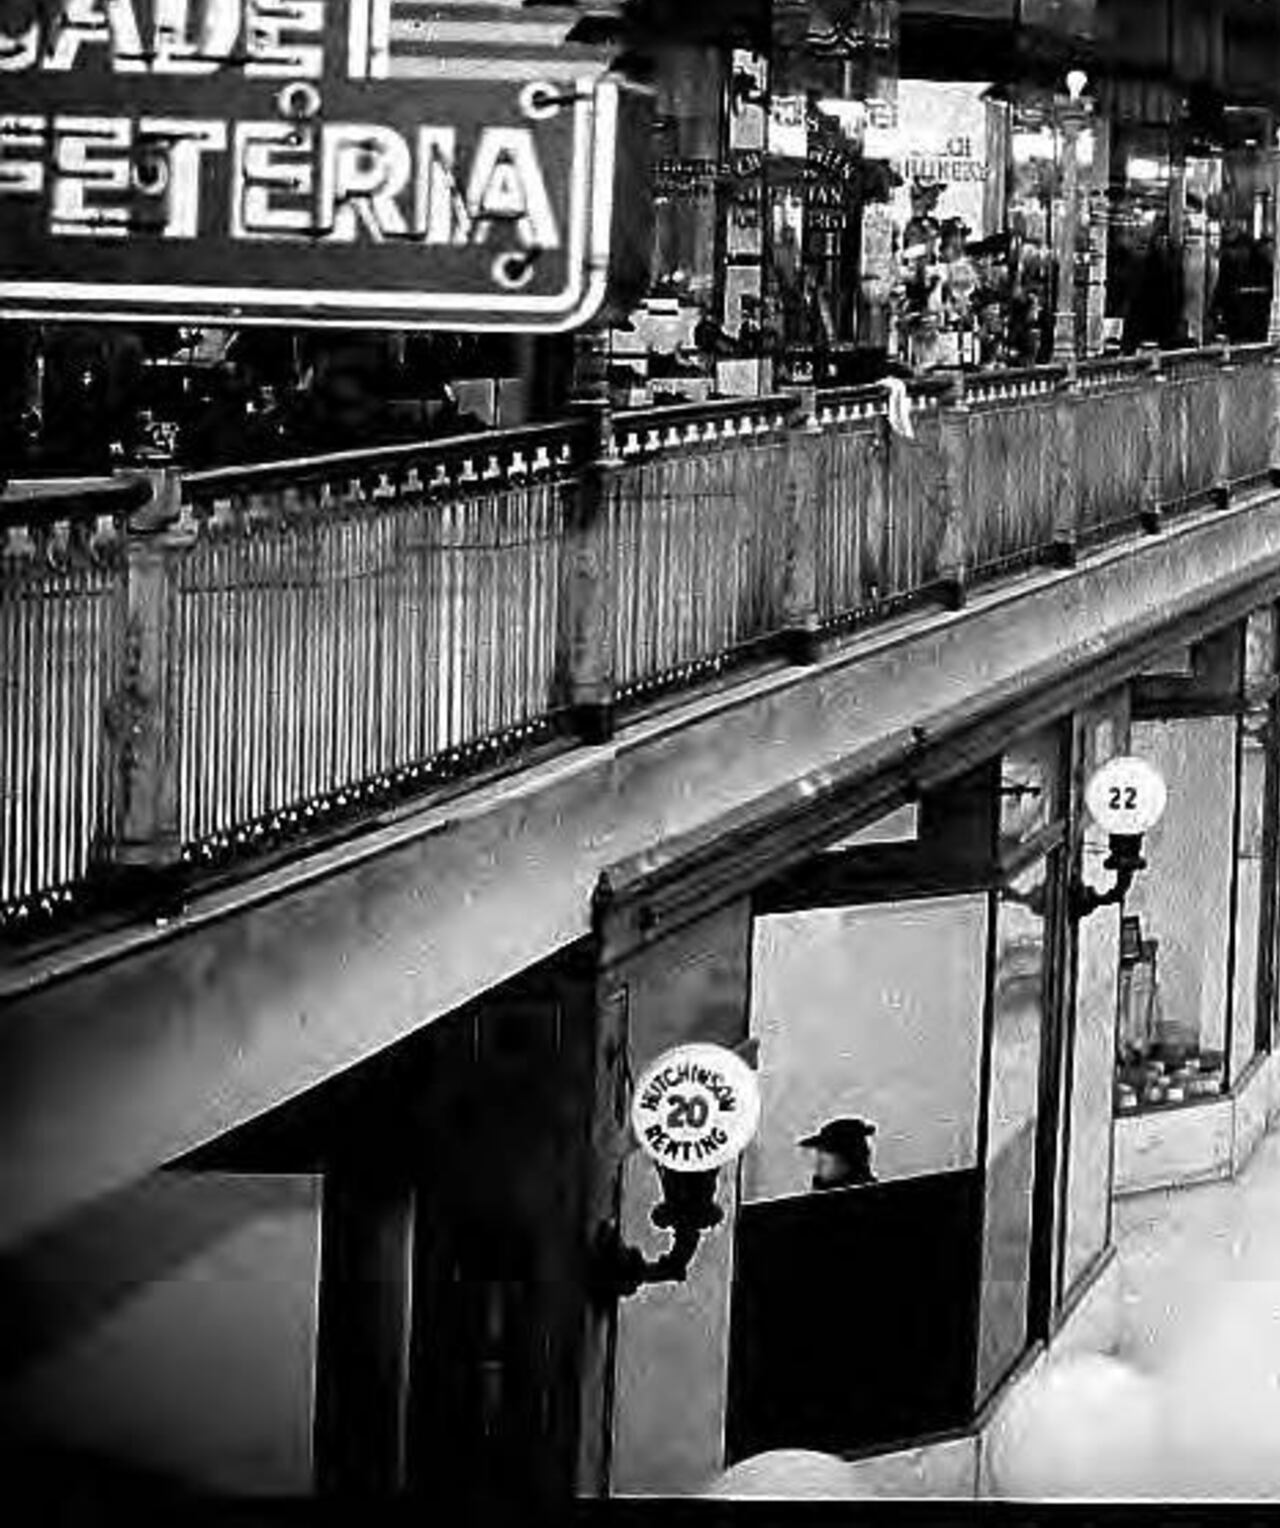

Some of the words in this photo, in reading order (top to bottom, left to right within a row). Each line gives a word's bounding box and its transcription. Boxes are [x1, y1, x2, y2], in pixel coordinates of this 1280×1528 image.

[1108, 786, 1138, 810] 22
[640, 1062, 736, 1112] HUTCHINSON
[666, 1094, 709, 1129] 20
[644, 1124, 729, 1162] RENTING
